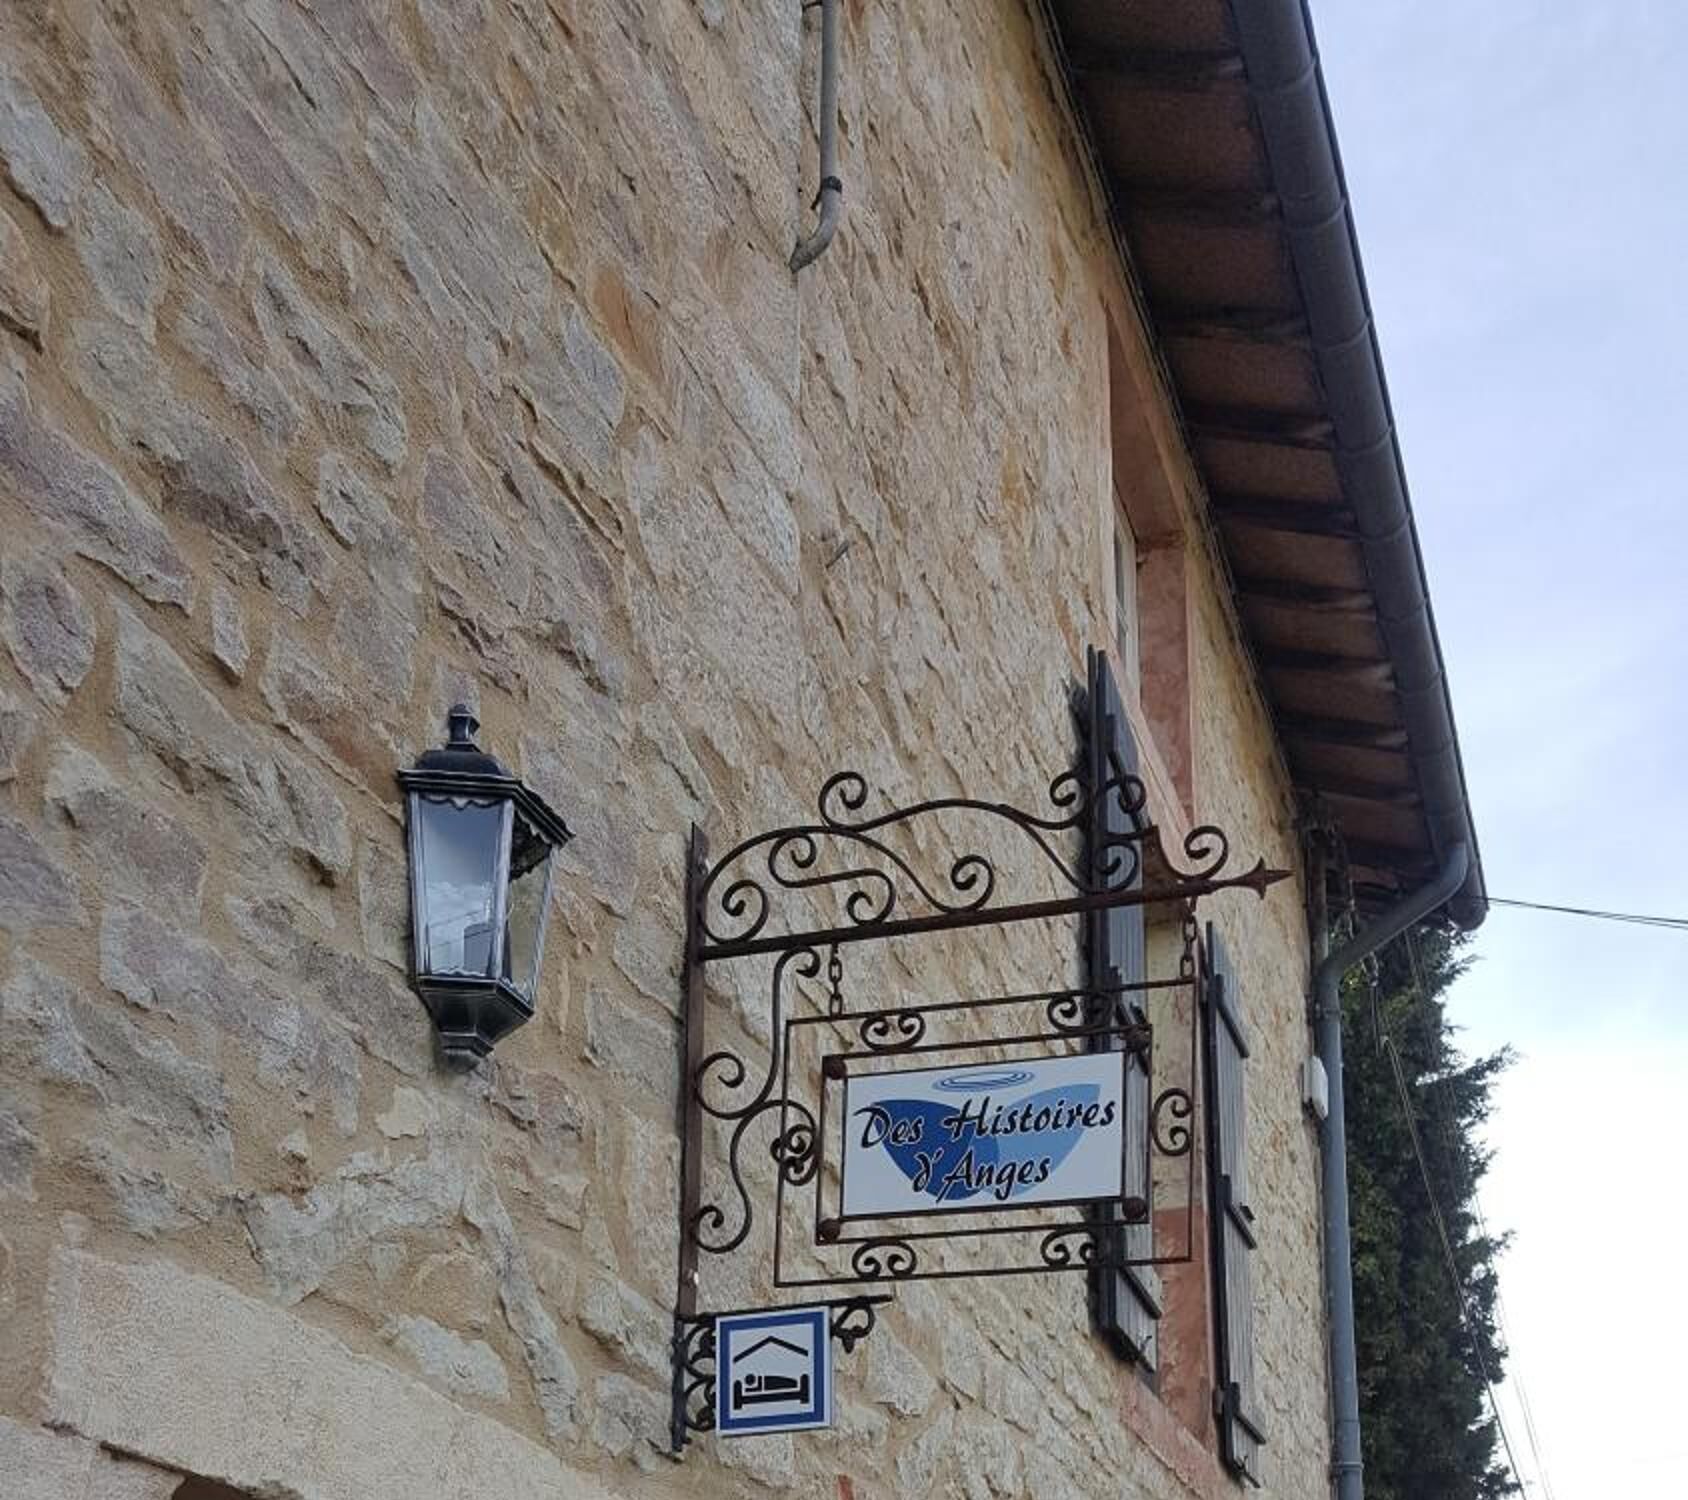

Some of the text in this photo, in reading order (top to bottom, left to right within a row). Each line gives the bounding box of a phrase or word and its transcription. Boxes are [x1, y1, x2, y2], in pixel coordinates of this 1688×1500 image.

[853, 1096, 1115, 1148] Des Histoires
[912, 1148, 1051, 1203] d'Anges
